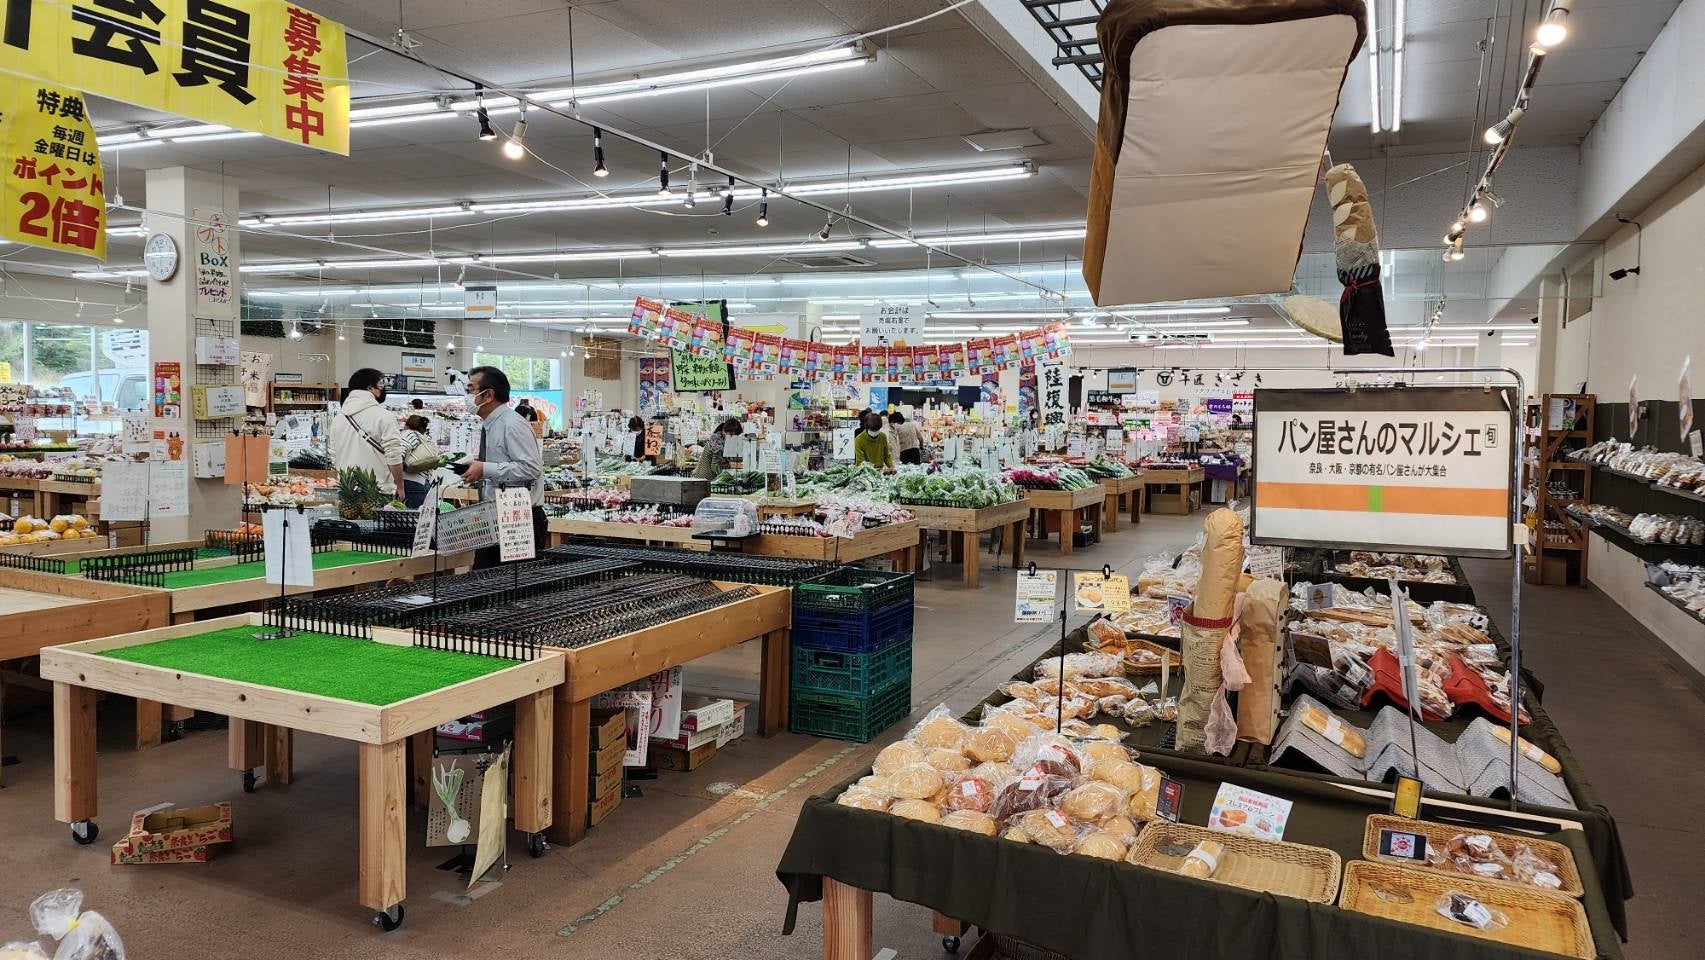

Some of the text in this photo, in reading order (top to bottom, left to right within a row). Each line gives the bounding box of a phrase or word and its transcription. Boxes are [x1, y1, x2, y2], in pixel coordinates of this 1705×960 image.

[283, 7, 324, 144] 募集中
[37, 88, 84, 122] 特典
[34, 139, 96, 166] 金曜日は
[52, 125, 84, 146] 毎週
[13, 156, 103, 196] ポイント
[18, 191, 100, 250] 2倍
[1278, 417, 1482, 457] パン屋さんのマルシェ
